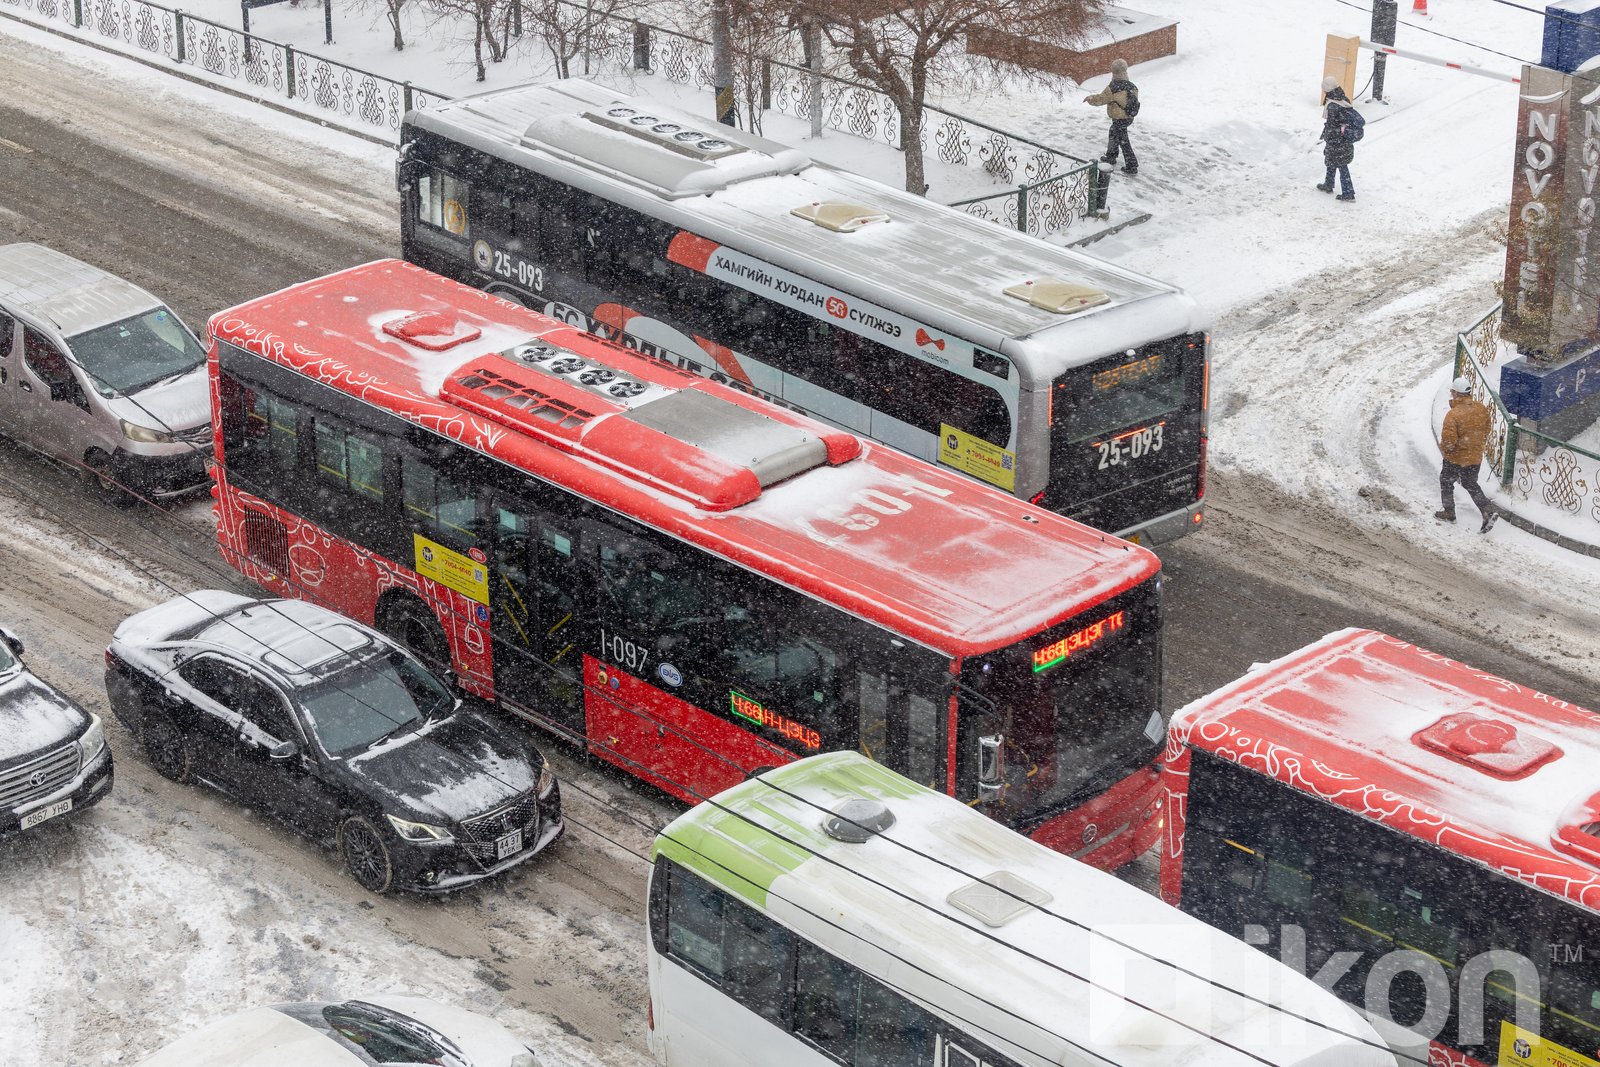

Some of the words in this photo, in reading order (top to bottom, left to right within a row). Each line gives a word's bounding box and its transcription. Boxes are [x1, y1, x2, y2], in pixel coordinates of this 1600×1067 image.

[494, 250, 543, 292] 25-093
[715, 255, 773, 287] ХАМГИЙН
[775, 278, 825, 308] ХУРДАН
[849, 308, 902, 338] СҮЛЖЭЭ
[921, 350, 950, 366] mobicom
[1098, 425, 1163, 470] 25-093
[600, 628, 649, 672] 1-097
[27, 810, 48, 826] 8867
